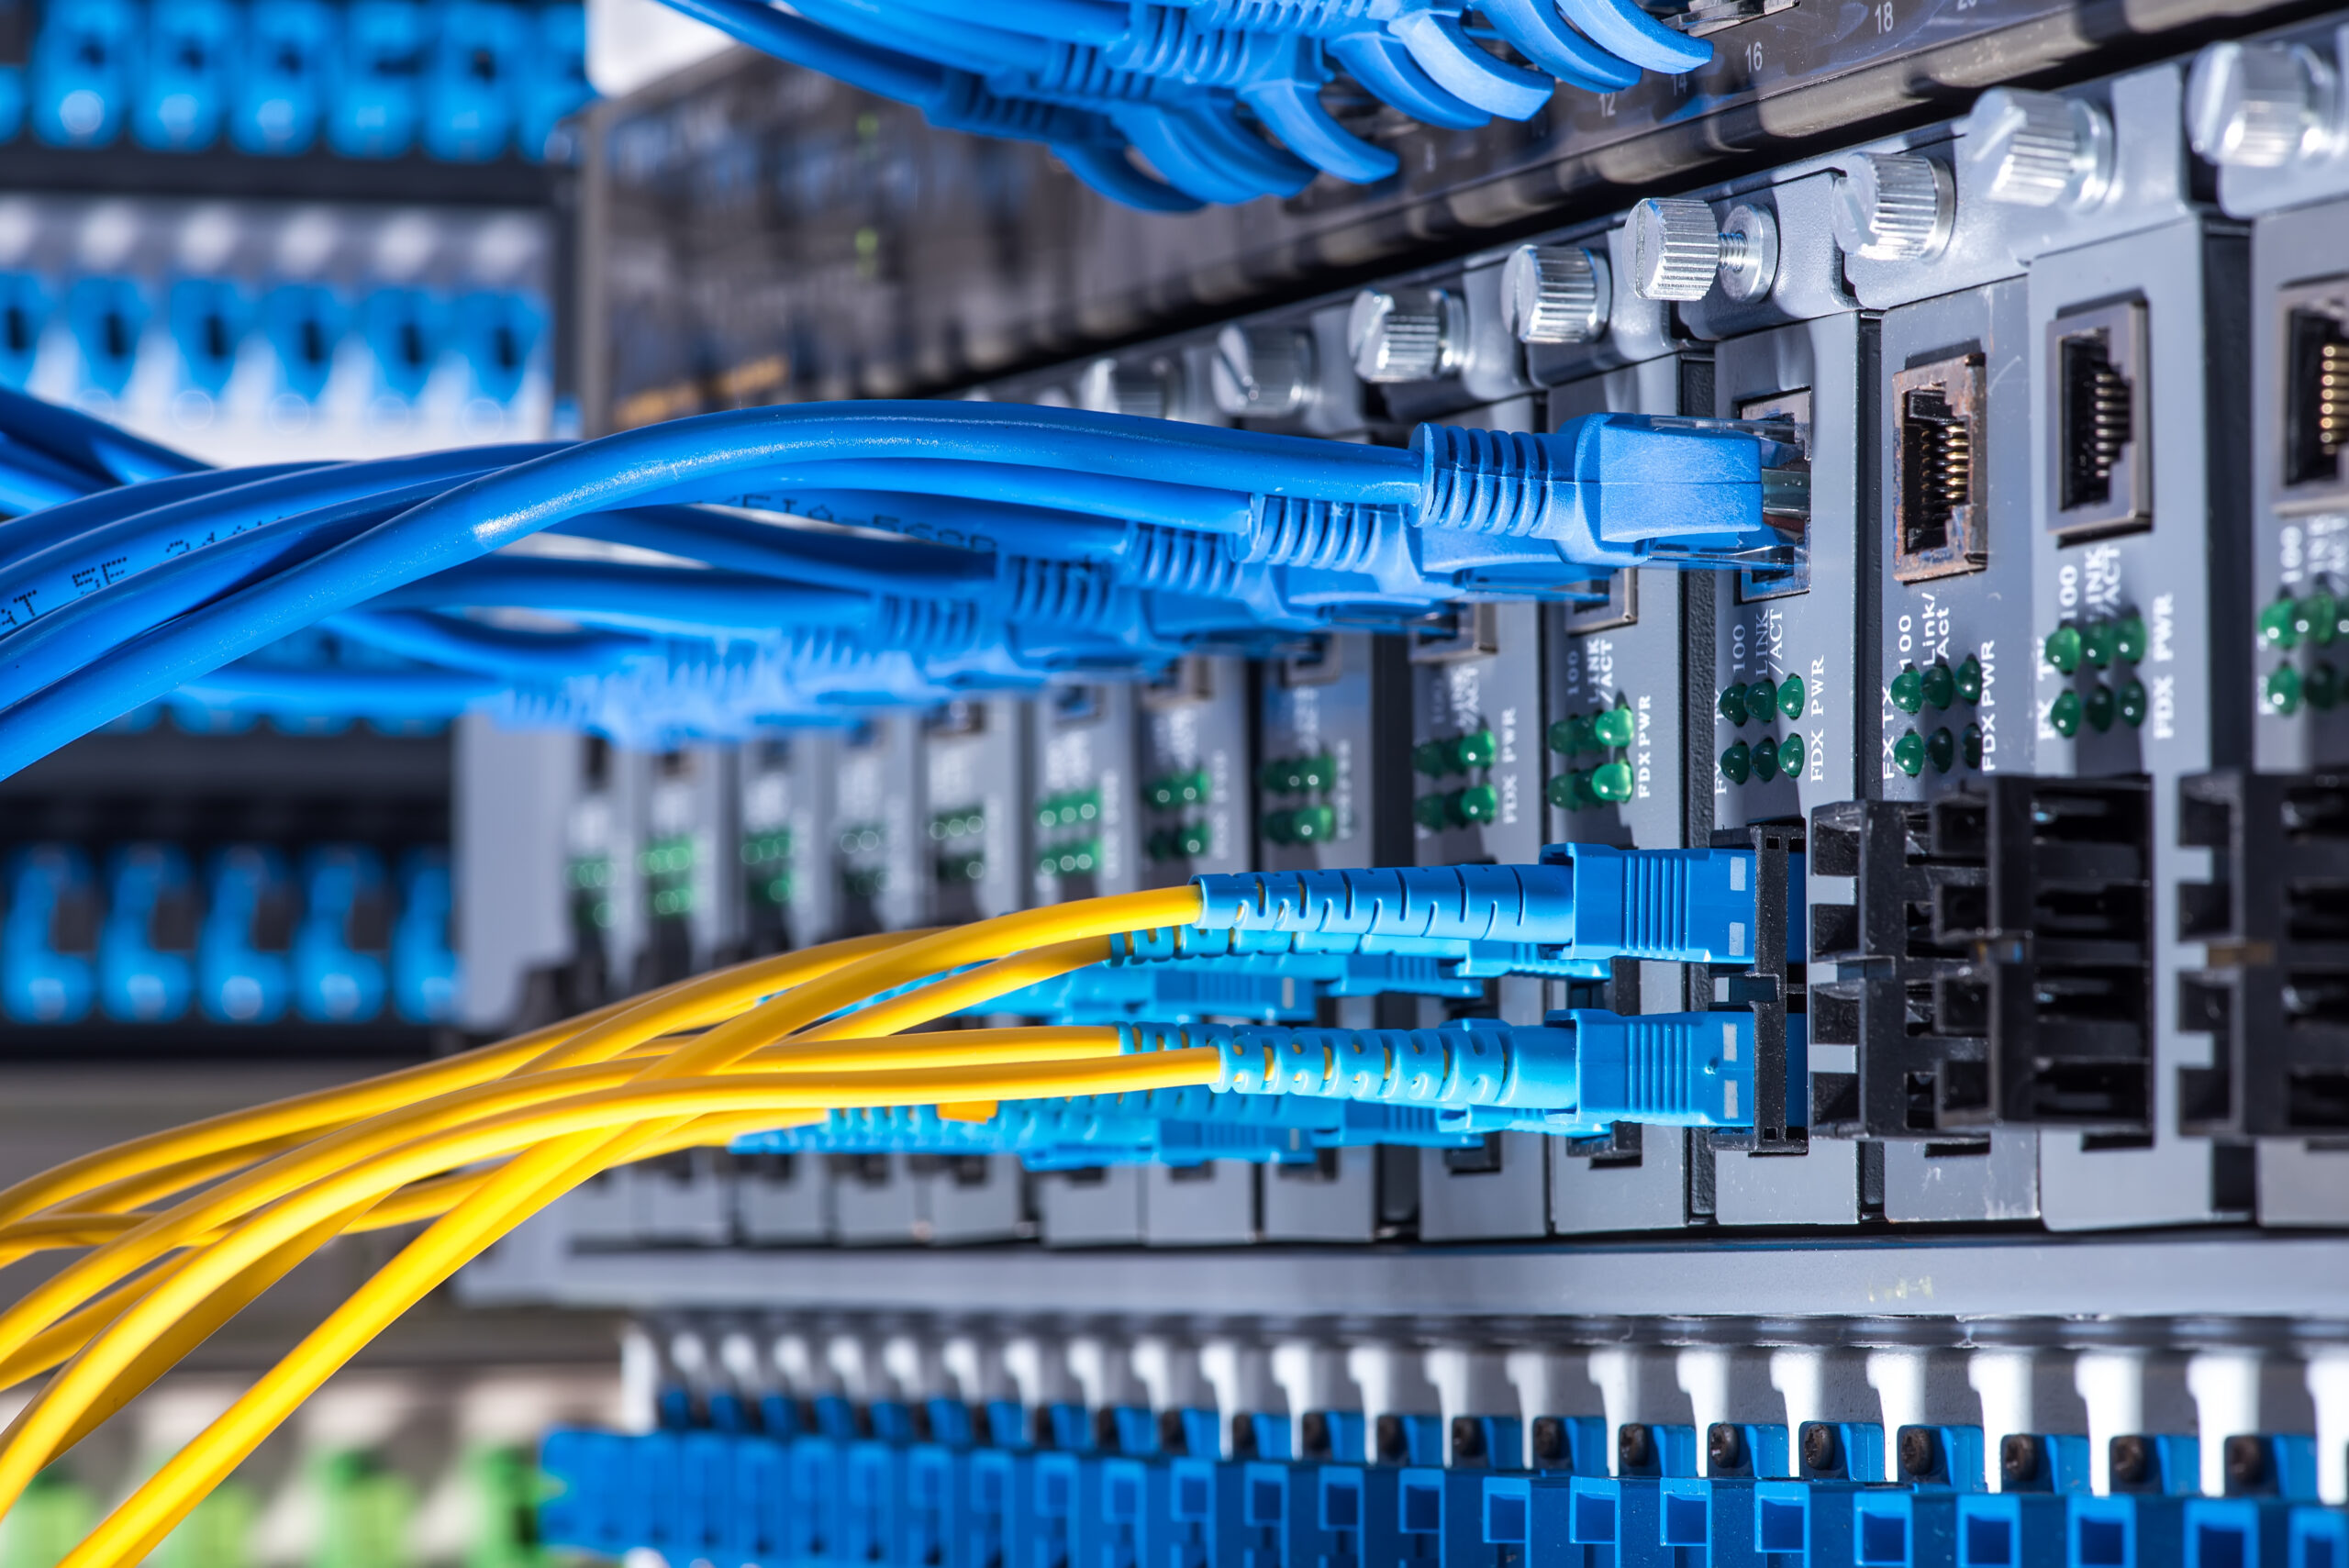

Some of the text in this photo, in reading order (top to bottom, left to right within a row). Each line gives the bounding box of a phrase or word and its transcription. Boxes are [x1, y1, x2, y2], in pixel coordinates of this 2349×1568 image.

[1875, 2, 1894, 34] 18
[1671, 72, 1688, 95] 14
[1744, 41, 1764, 72] 16
[1598, 93, 1617, 117] 12
[2058, 564, 2078, 620] 100
[1733, 623, 1746, 673] 100
[1755, 608, 1769, 676] LINK
[1768, 608, 1783, 675] /ACT
[1898, 614, 1912, 667] 100
[1921, 593, 1936, 666] Link/
[1935, 606, 1950, 660] Act
[1587, 638, 1600, 704] LINK
[1599, 639, 1614, 704] /ACT
[2153, 591, 2175, 740] FDX PWR
[1500, 706, 1518, 762] PWR
[1810, 654, 1824, 783] FDX PWR
[1882, 685, 1895, 780] FX TX
[1980, 639, 1997, 773] FDX PWR
[1638, 695, 1652, 798] FDX PWR
